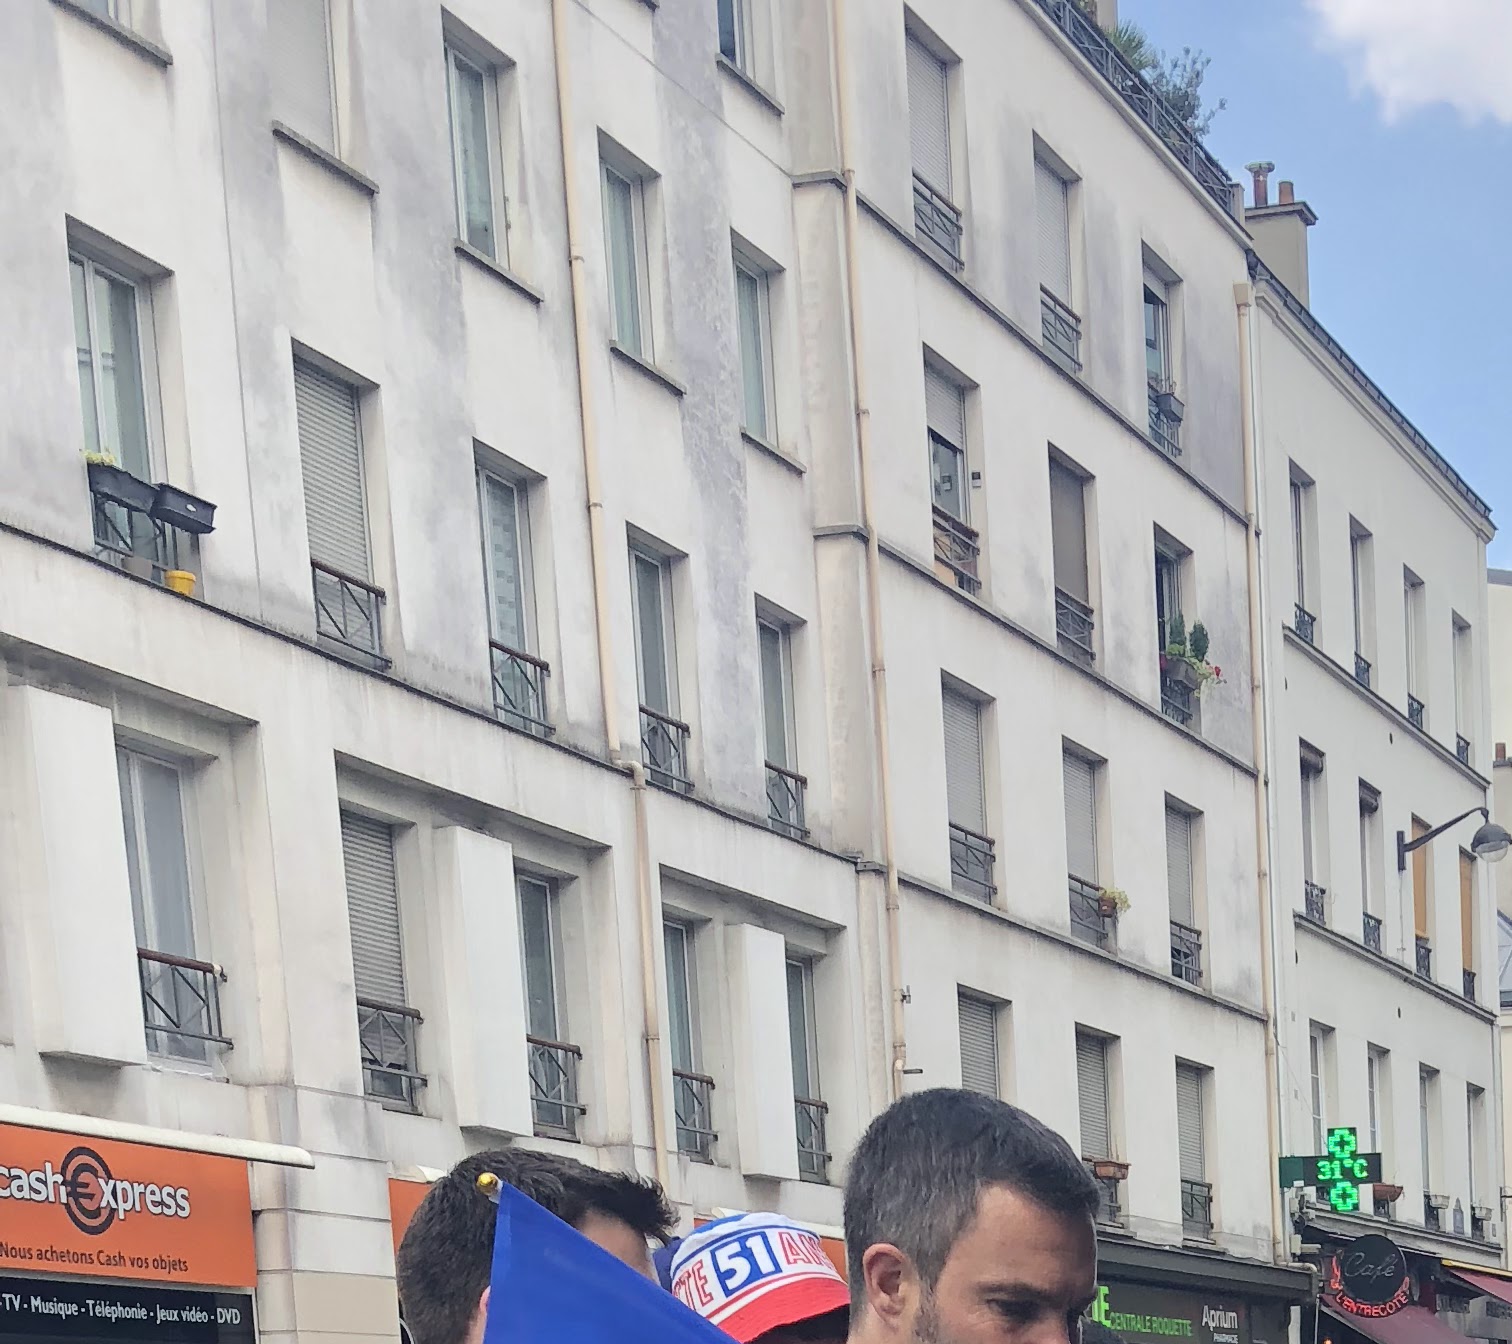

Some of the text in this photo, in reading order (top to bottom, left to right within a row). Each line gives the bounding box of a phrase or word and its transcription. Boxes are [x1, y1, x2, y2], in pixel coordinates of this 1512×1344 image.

[0, 1242, 189, 1274] Nous achetons Cash vos objets
[714, 1233, 779, 1293] 51
[1344, 1252, 1398, 1284] Café
[30, 1296, 78, 1319] Musique
[86, 1300, 148, 1322] Téléphonie
[156, 1304, 178, 1324] Jeux
[181, 1305, 209, 1323] vidéo
[217, 1308, 241, 1324] DVD
[1110, 1312, 1151, 1333] CENTRALE
[1152, 1316, 1193, 1337] ROQUETTE
[1202, 1305, 1238, 1331] Aprium
